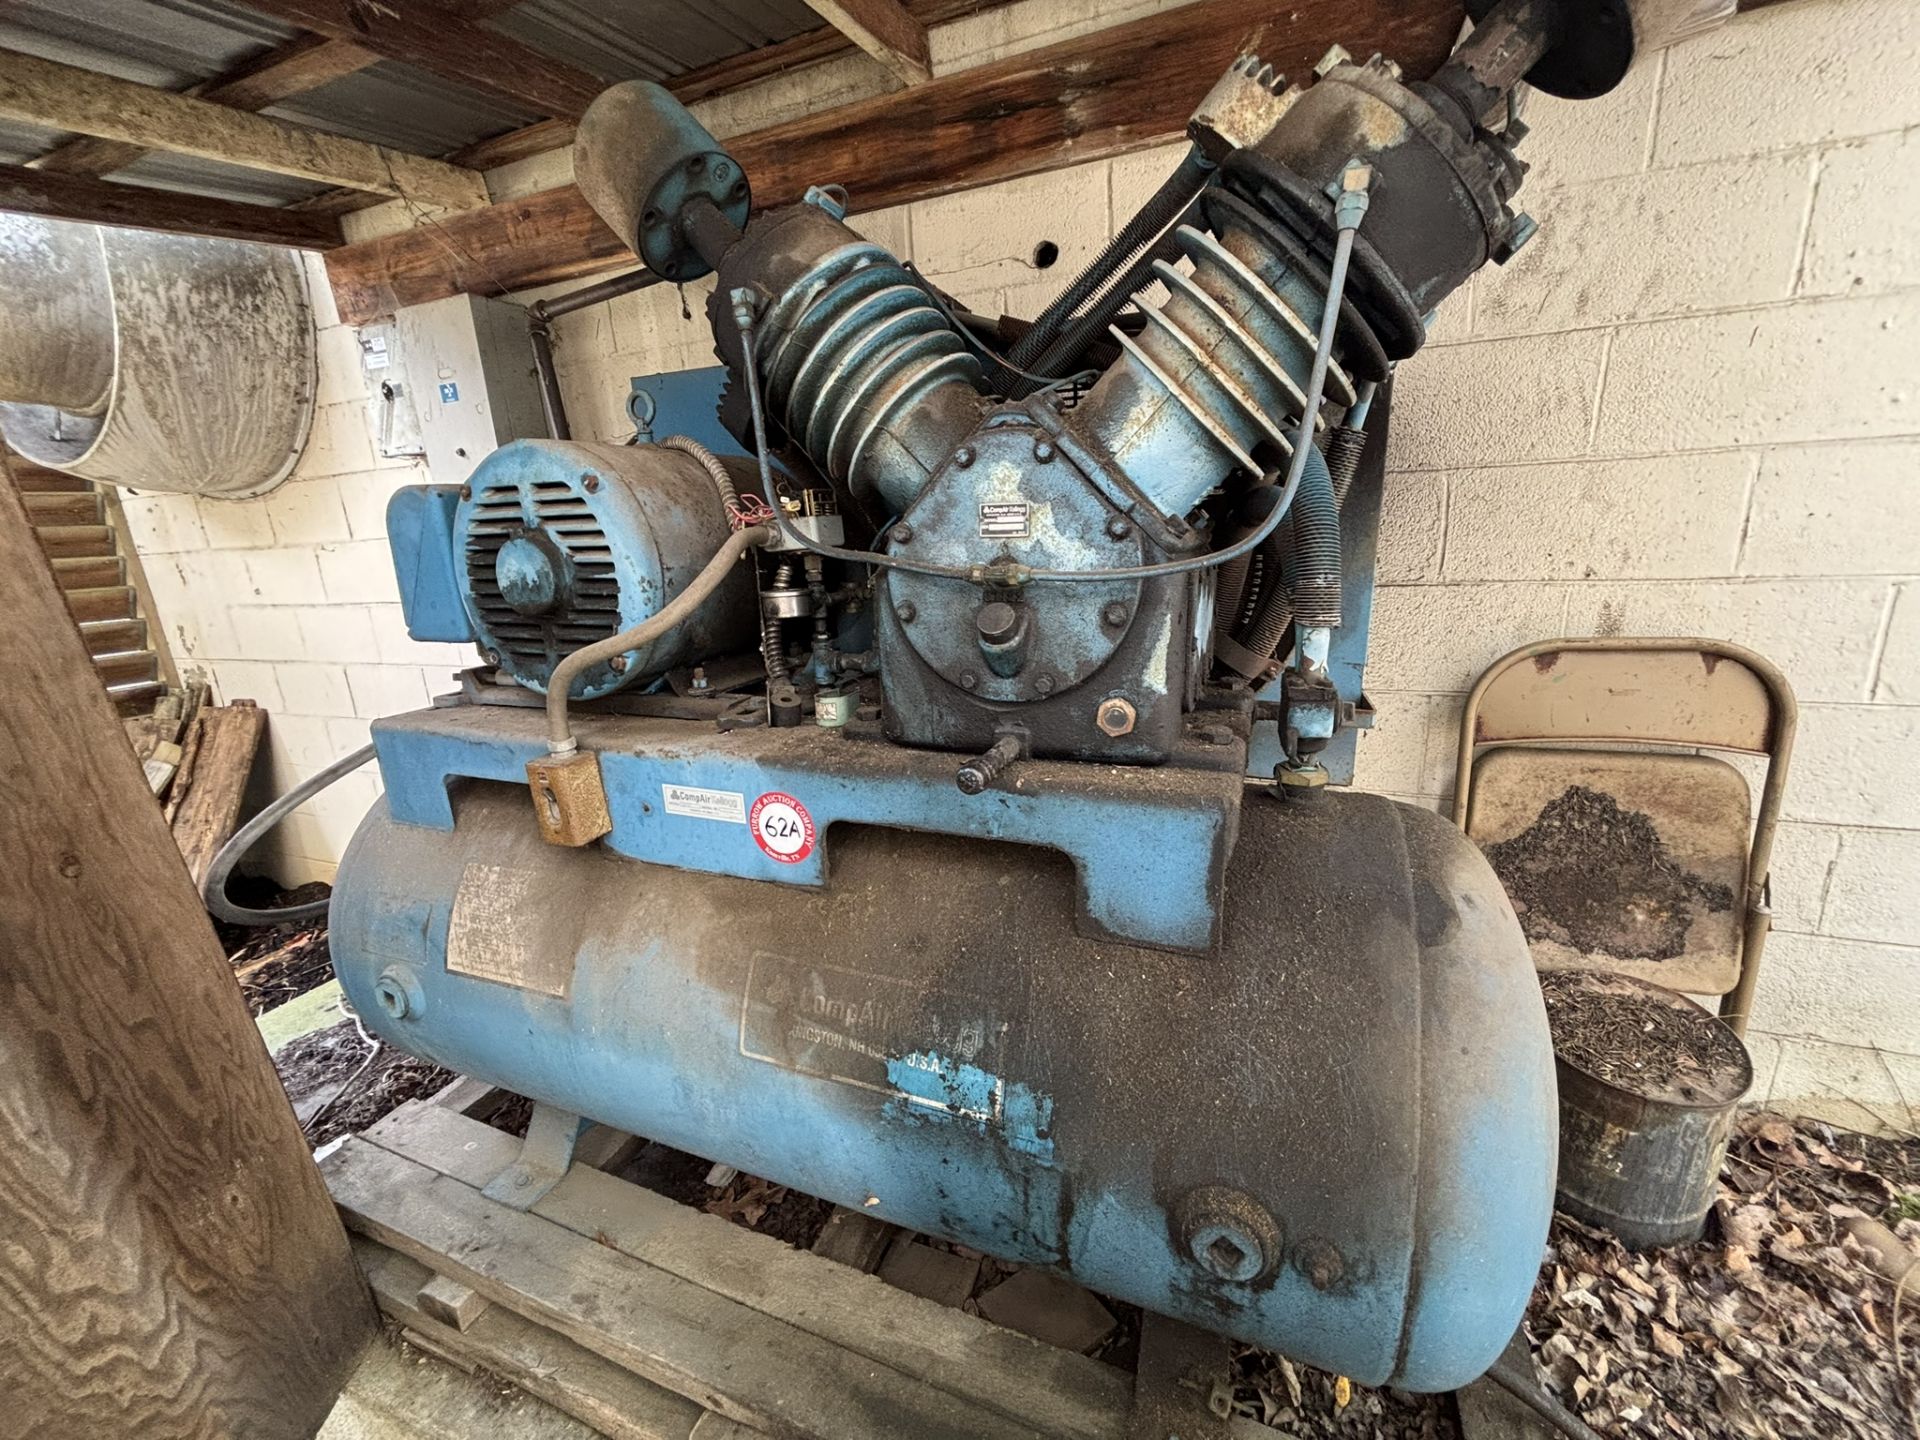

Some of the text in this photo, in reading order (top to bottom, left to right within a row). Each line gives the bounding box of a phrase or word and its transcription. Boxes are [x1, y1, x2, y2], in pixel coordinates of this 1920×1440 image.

[680, 791, 710, 804] CompAir
[751, 794, 815, 849] FURROW AUCTION COMPANY
[765, 815, 801, 838] 62A
